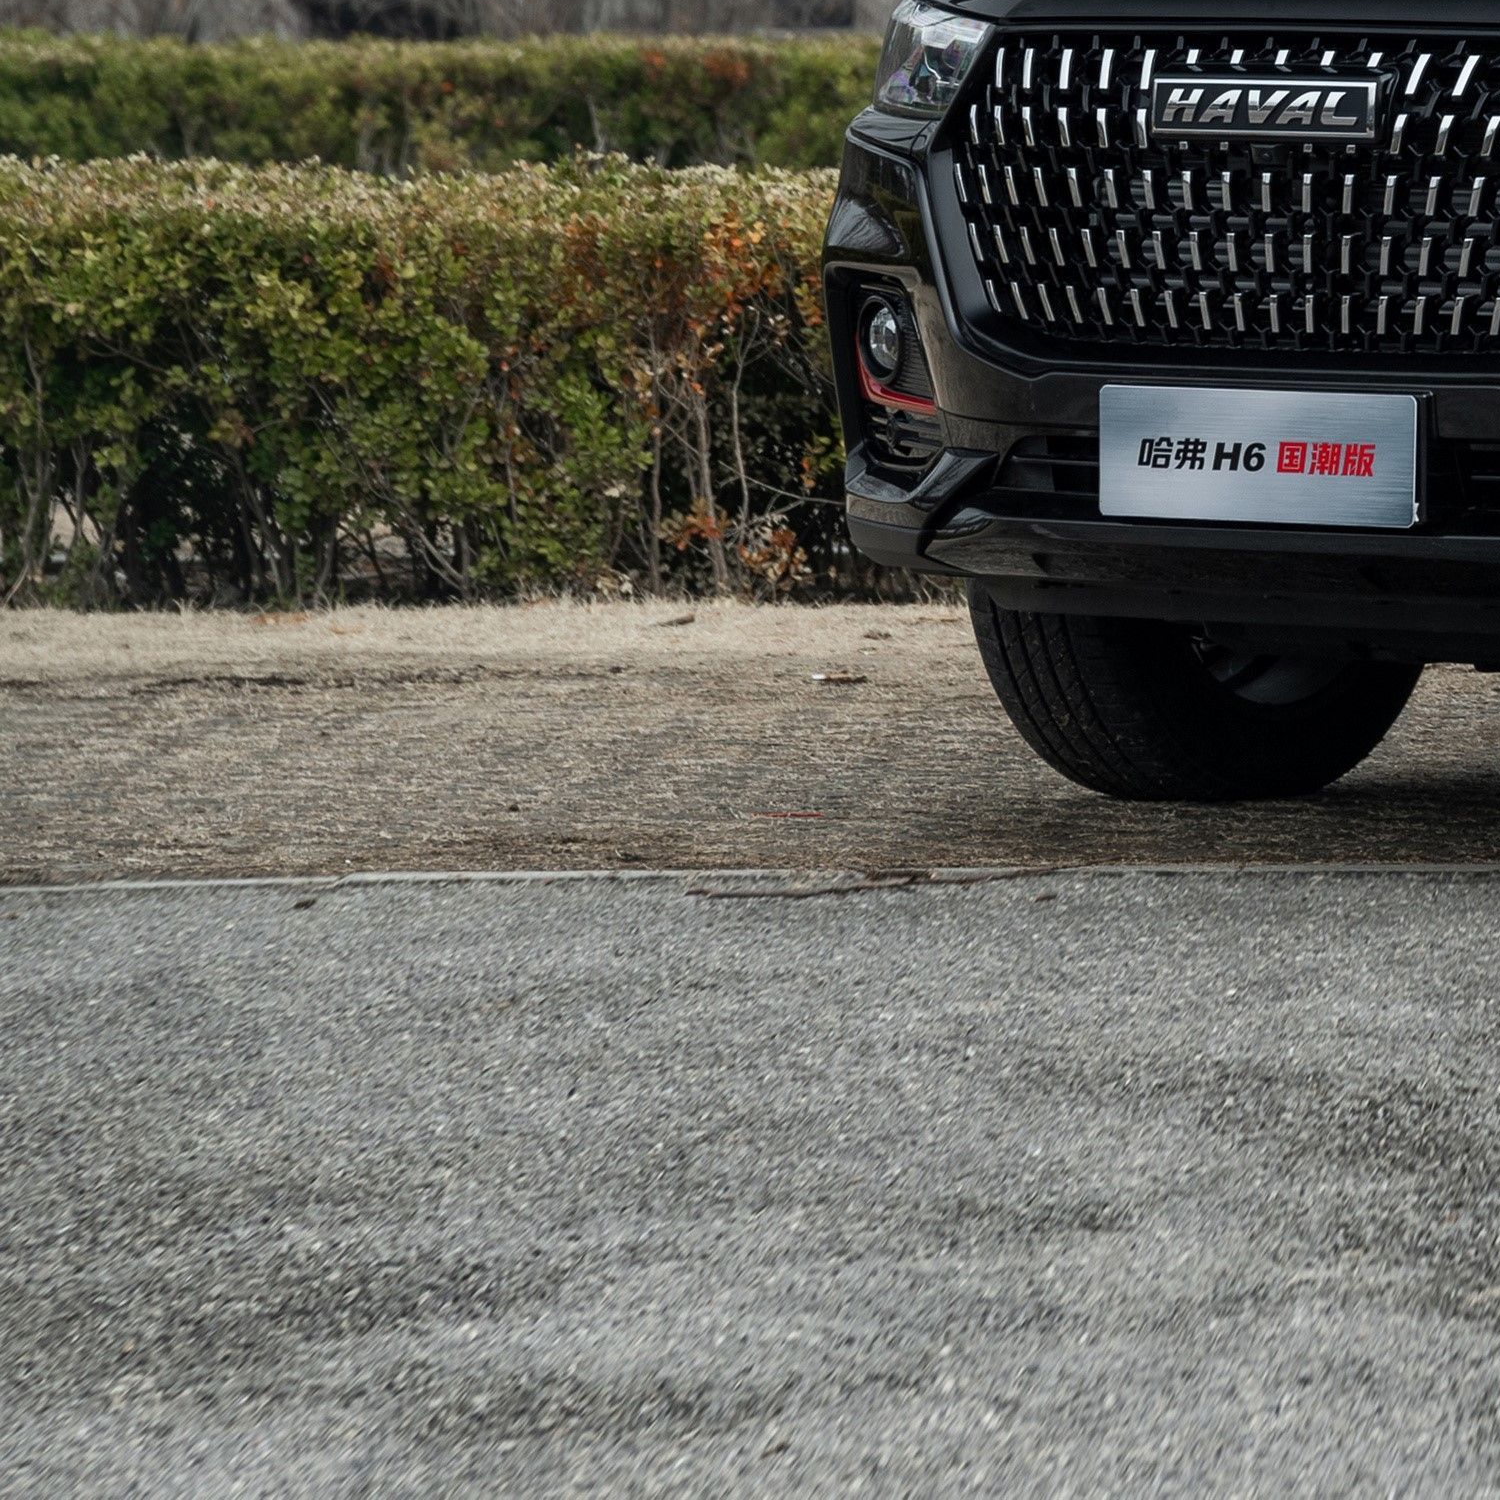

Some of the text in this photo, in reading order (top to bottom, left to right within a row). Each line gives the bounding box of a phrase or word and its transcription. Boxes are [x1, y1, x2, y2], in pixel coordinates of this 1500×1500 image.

[1162, 88, 1357, 125] HAVAL
[1137, 436, 1376, 477] 哈弗 H6 国潮版
